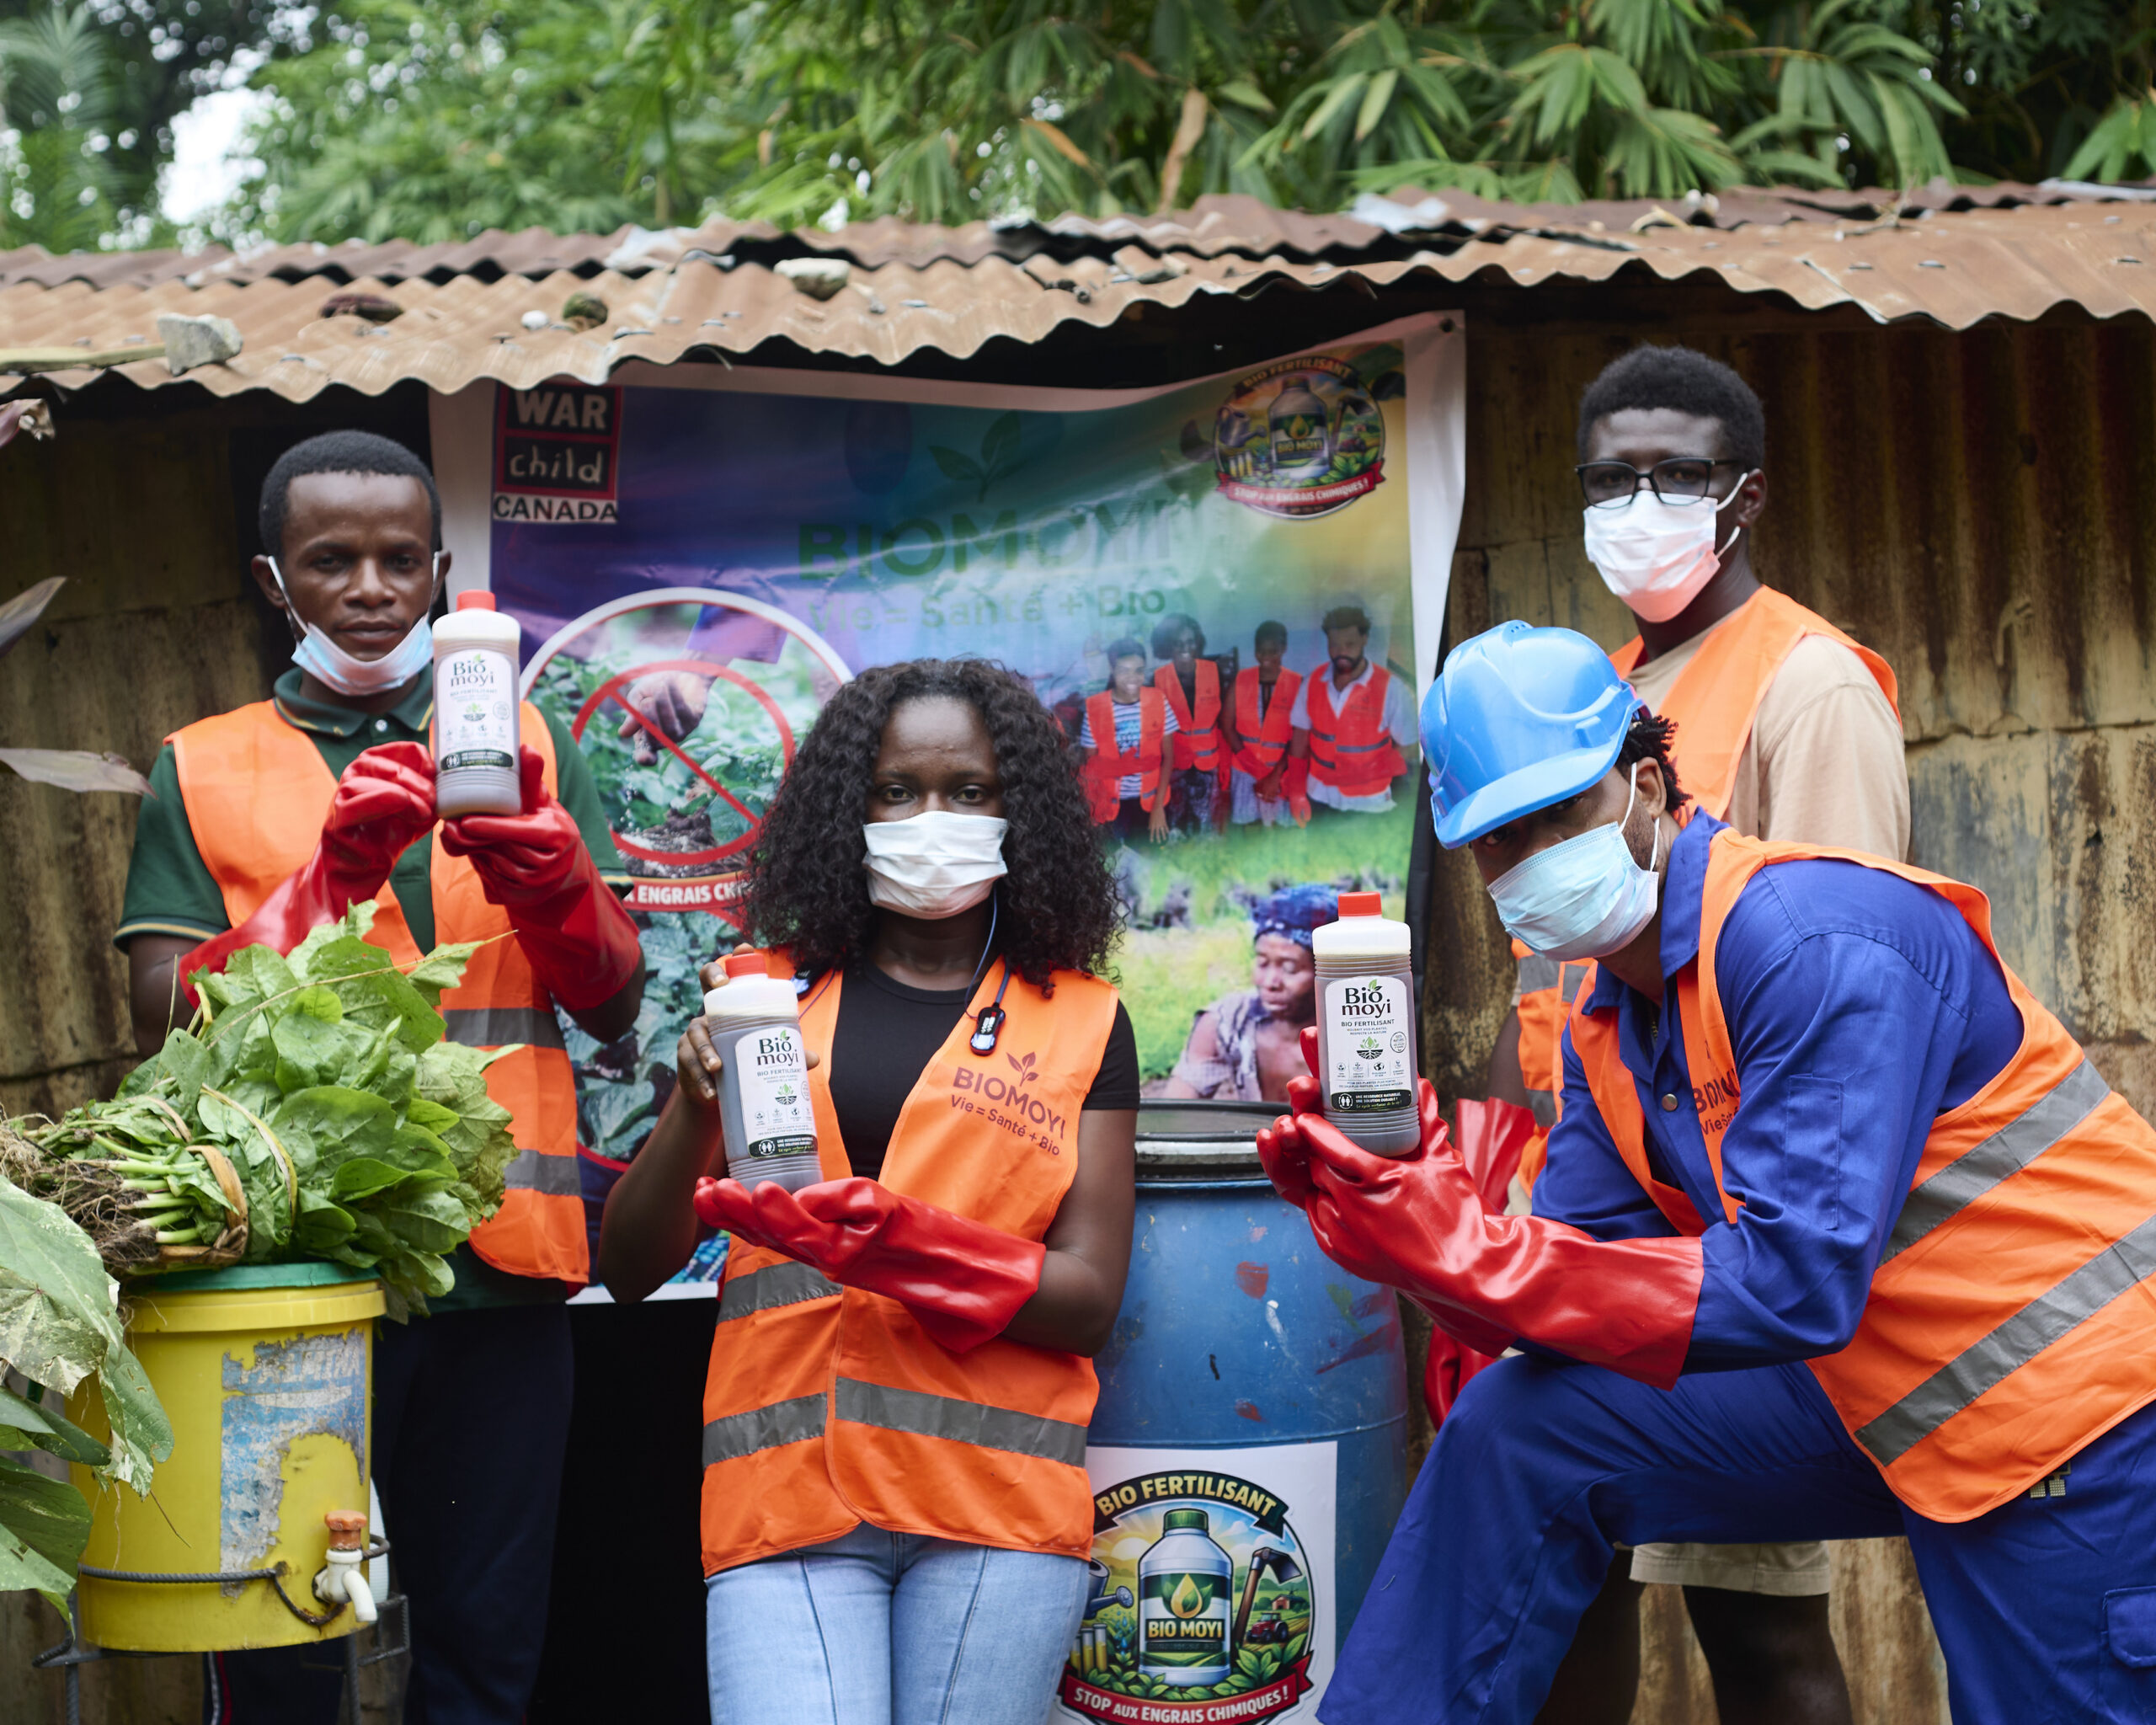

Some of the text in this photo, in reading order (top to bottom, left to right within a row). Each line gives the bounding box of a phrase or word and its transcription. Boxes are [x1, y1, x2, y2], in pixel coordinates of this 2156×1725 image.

[514, 390, 608, 430] WAR
[510, 445, 603, 483] child
[1234, 487, 1258, 499] STOP
[1276, 491, 1315, 503] ENGRAIS
[494, 494, 619, 521] CANADA
[798, 499, 1171, 579] BIOMOYI
[808, 600, 873, 632] Vie
[921, 590, 1044, 628] Santé
[1098, 585, 1166, 617] Bio
[451, 671, 494, 686] moyi
[453, 660, 486, 676] Bio
[638, 884, 712, 905] ENGRAIS
[1345, 986, 1383, 1004] Bio
[1342, 999, 1391, 1018] moyi
[756, 1049, 799, 1066] moyi
[759, 1037, 792, 1054] Bio
[953, 1066, 1066, 1139] BIOMOYI
[951, 1094, 974, 1112] Vie
[988, 1108, 1027, 1137] Santé
[1038, 1135, 1060, 1156] Bio
[1096, 1475, 1277, 1516] BIO FERTILISANT
[1148, 1621, 1223, 1637] BIO MOYI
[1074, 1687, 1112, 1712] STOP
[1113, 1703, 1139, 1719] AUX
[1141, 1706, 1204, 1723] ENGRAIS
[1207, 1689, 1282, 1722] CHIMIQUES
